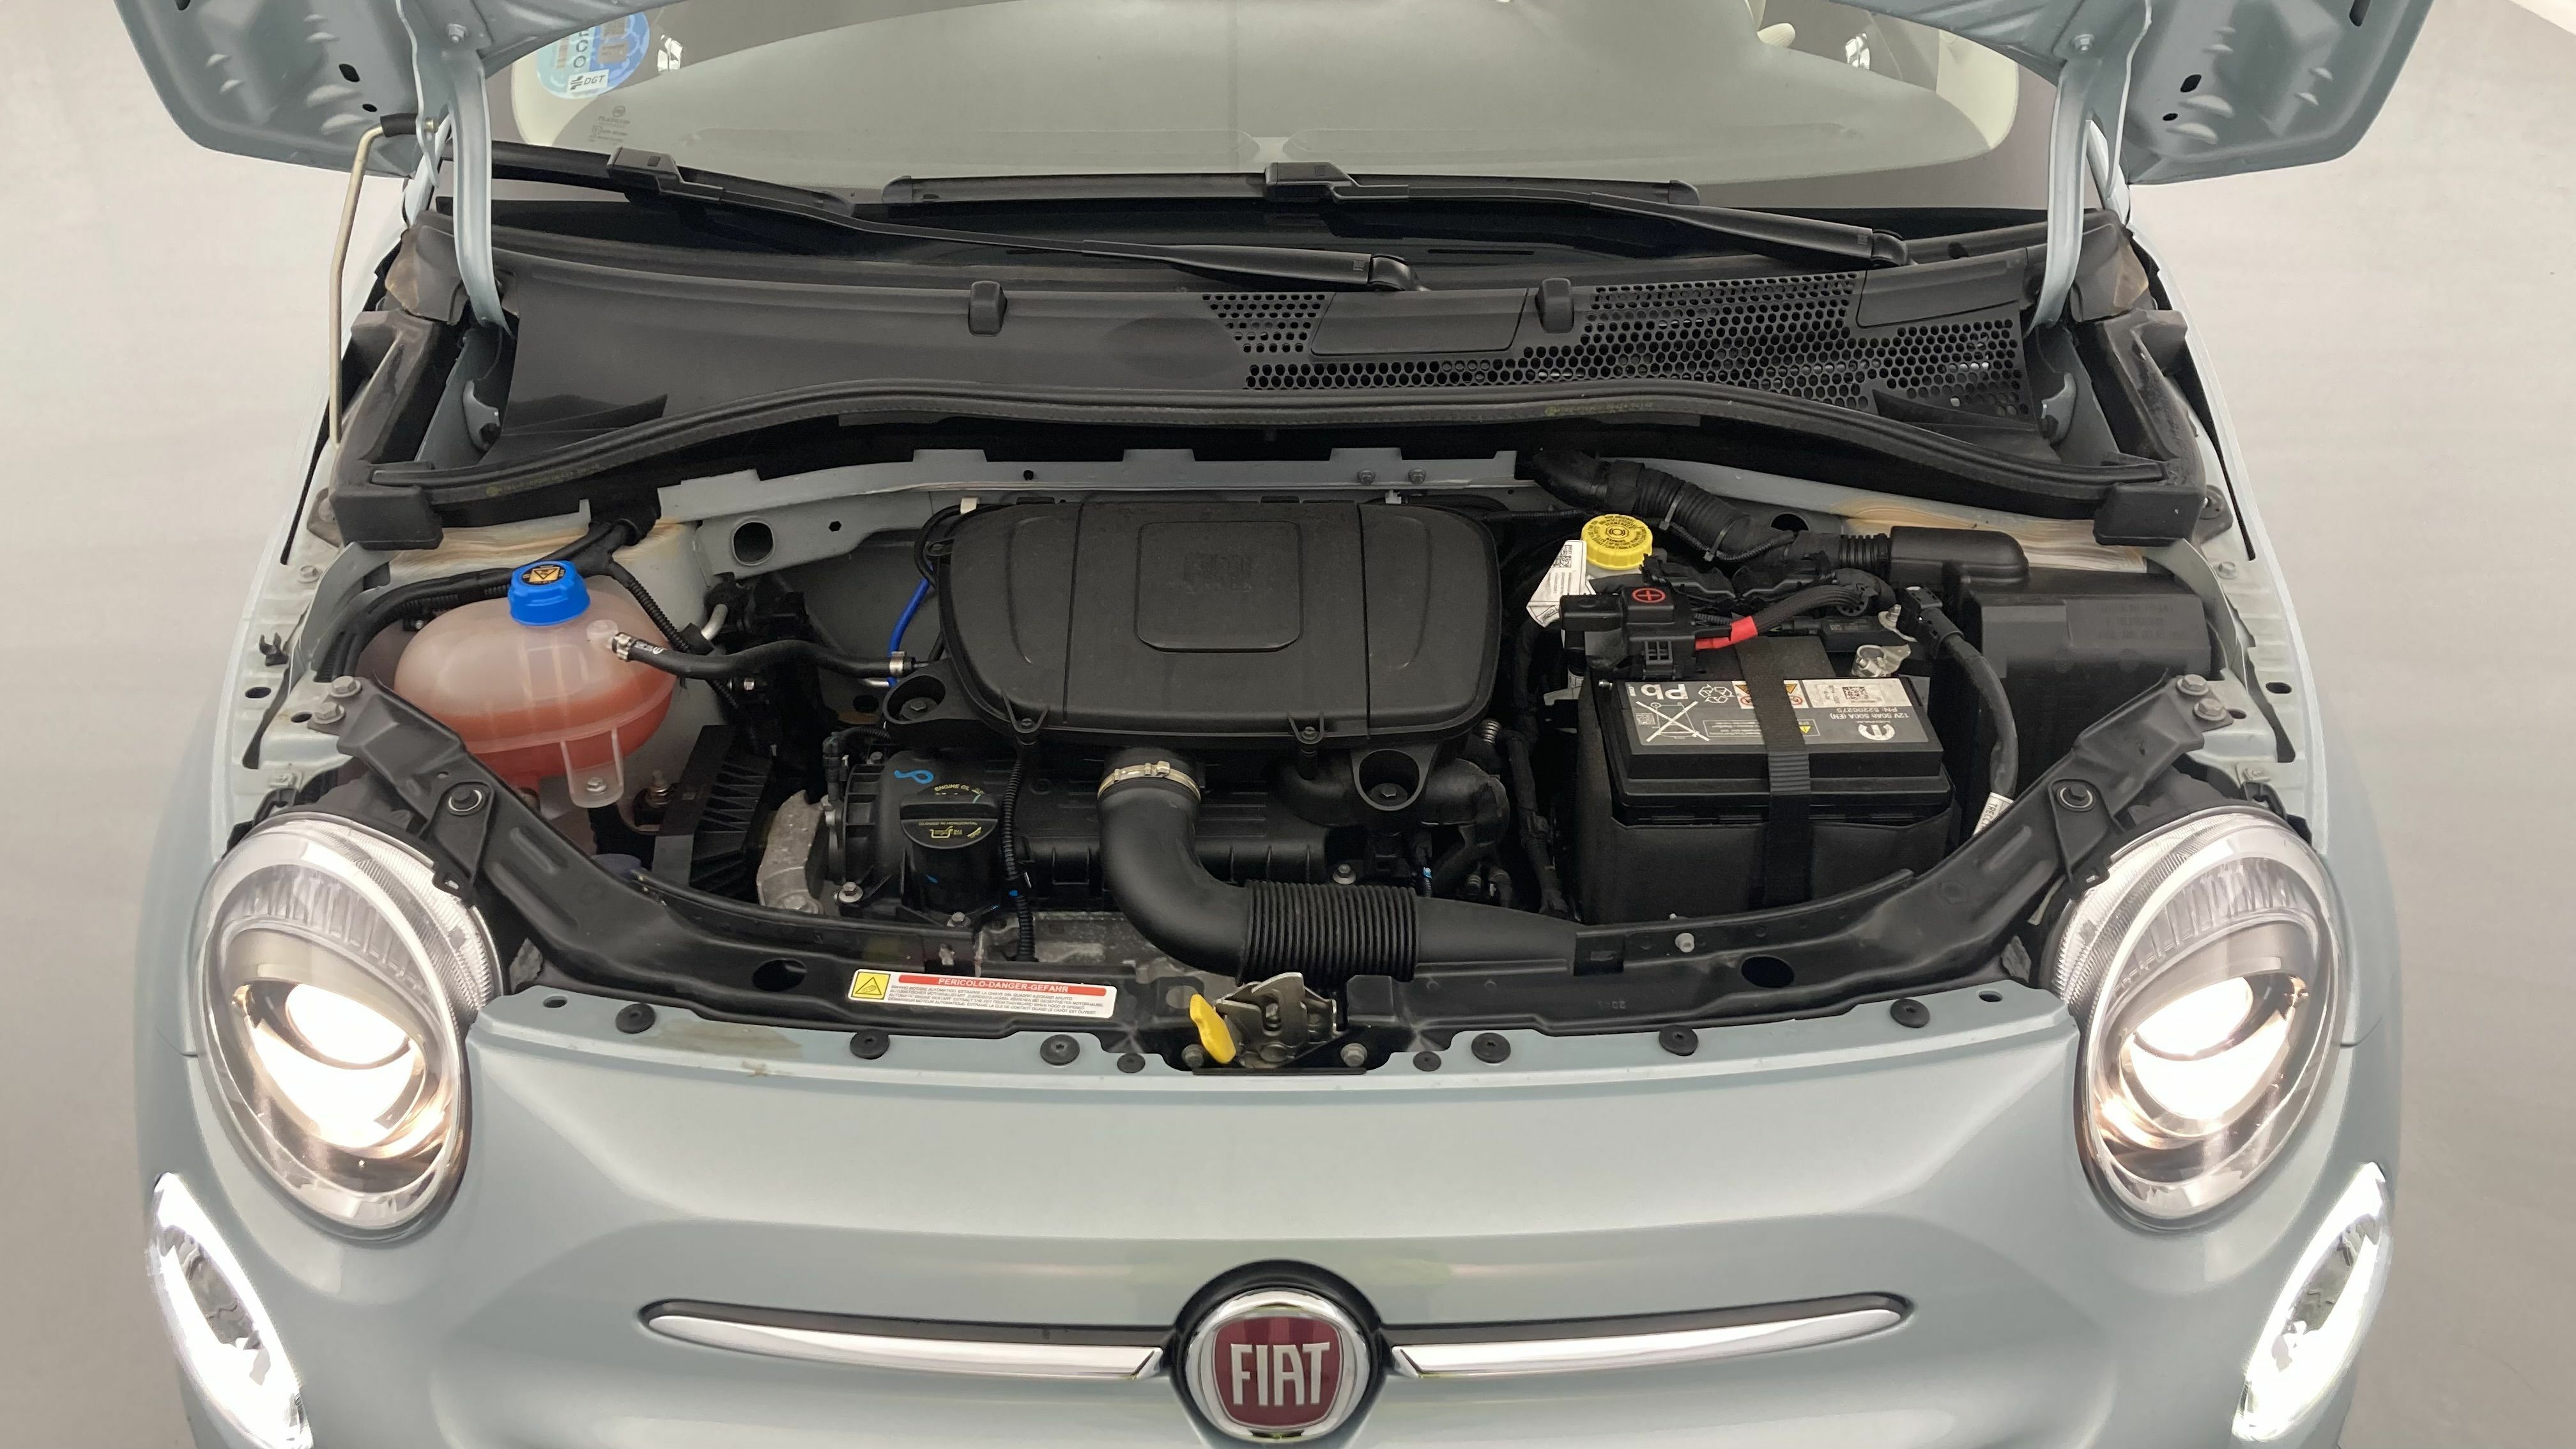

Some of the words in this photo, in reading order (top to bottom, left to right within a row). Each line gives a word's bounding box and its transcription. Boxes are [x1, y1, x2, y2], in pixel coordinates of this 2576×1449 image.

[583, 74, 606, 86] DGT
[1641, 683, 1689, 701] Pb
[937, 977, 1069, 994] PERICOLO-DANGER-GEFAHR
[1230, 1342, 1330, 1406] FIAT
